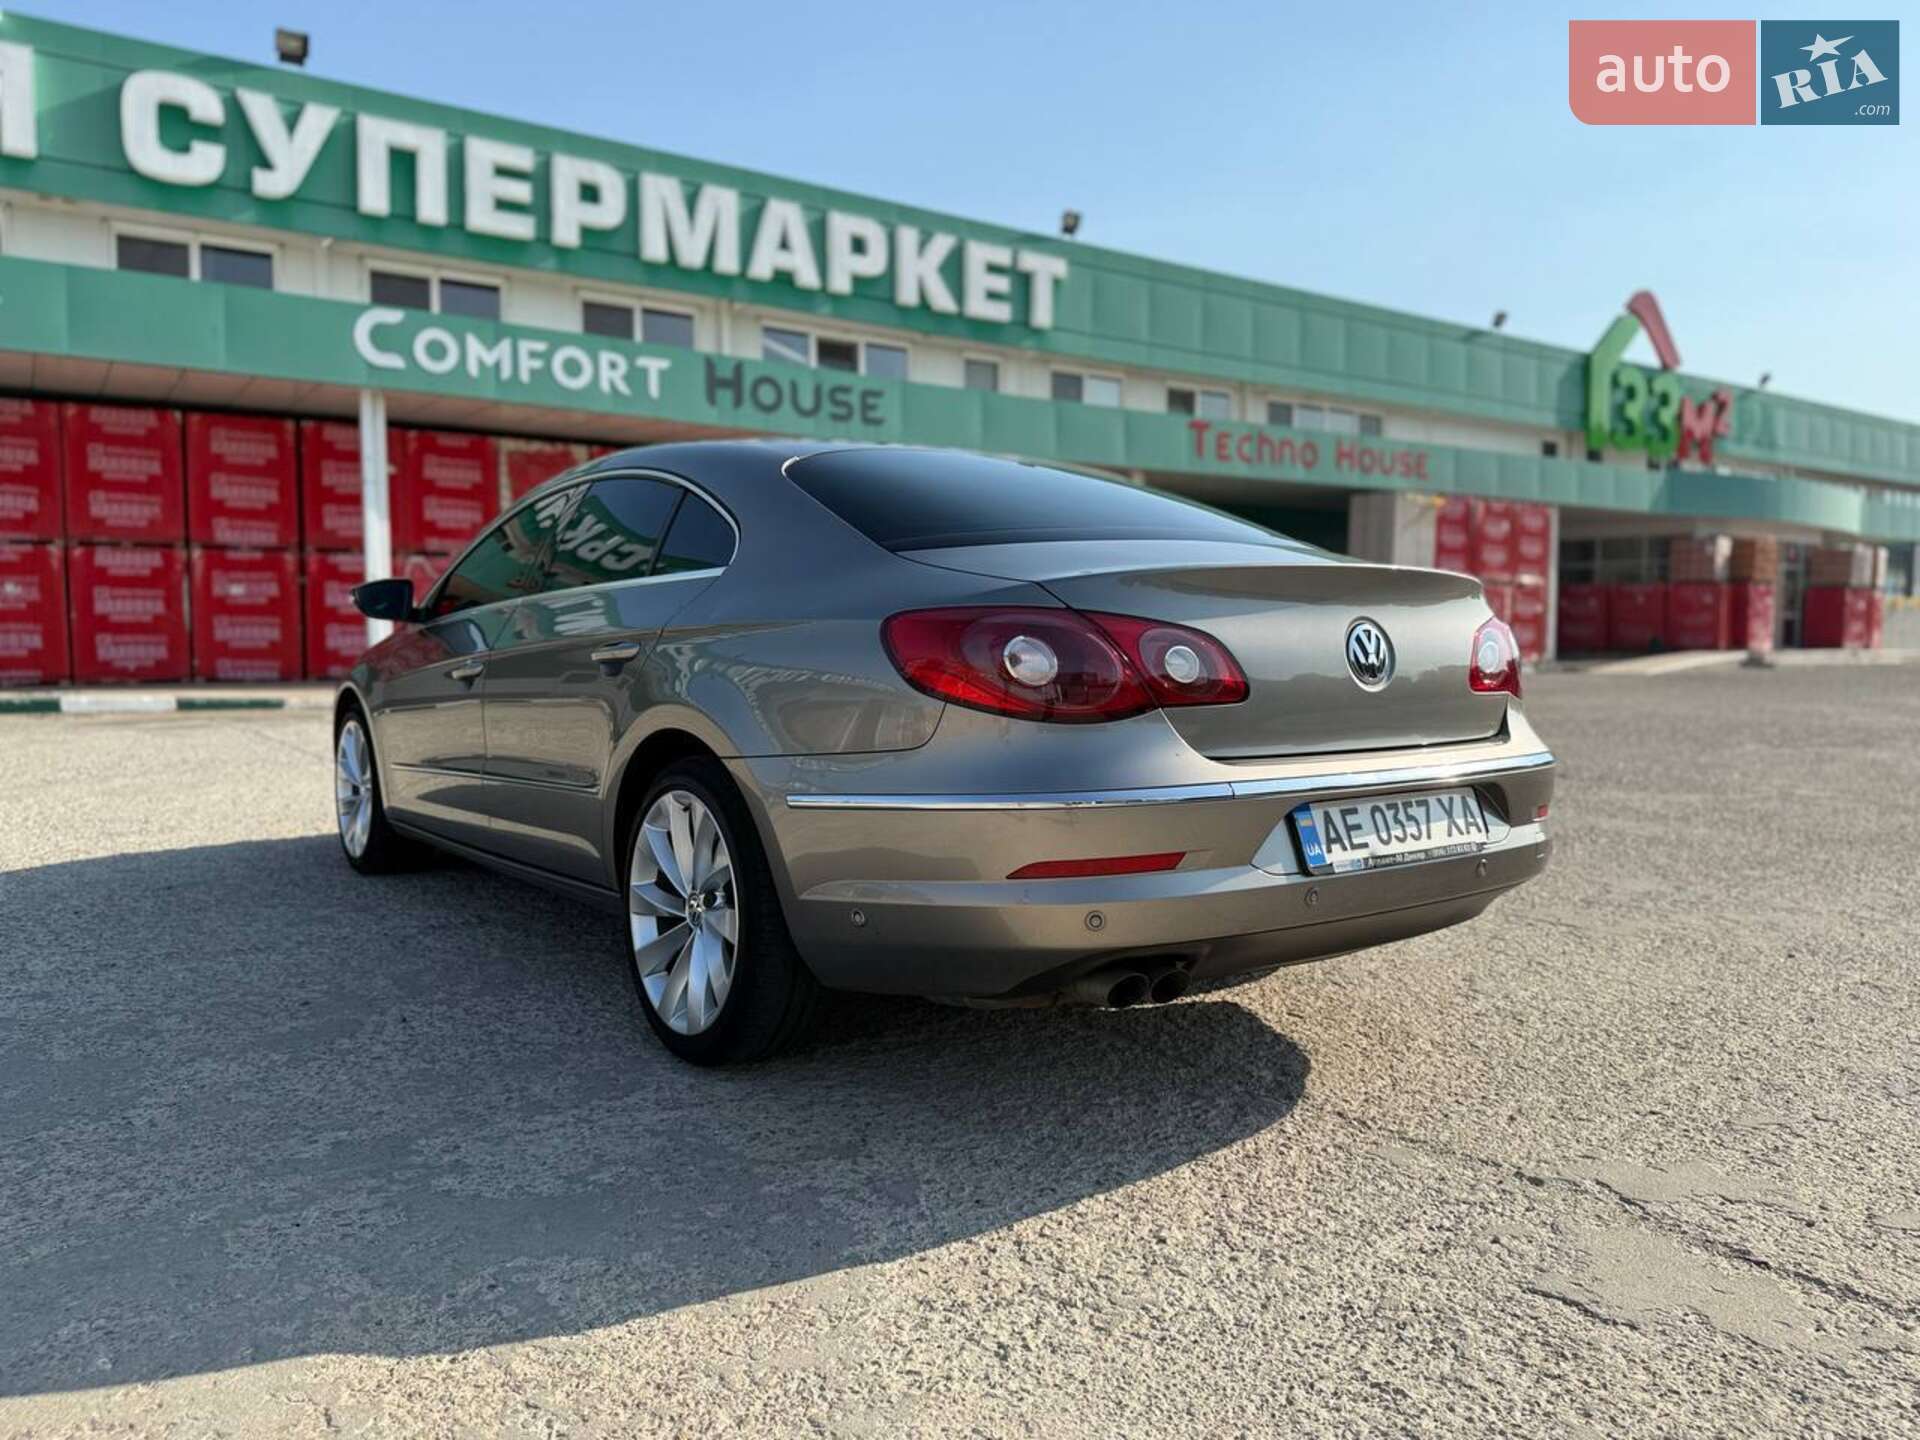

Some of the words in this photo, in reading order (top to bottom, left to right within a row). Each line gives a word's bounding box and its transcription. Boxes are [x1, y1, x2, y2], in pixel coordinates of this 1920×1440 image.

[120, 69, 1069, 329] СУПЕРМАРКЕТ
[352, 307, 671, 399] COMFORT
[704, 356, 886, 427] HOUSE
[1306, 841, 1322, 857] UA
[1323, 807, 1369, 853] AE
[1370, 799, 1432, 846] 0357
[1435, 796, 1483, 838] XA
